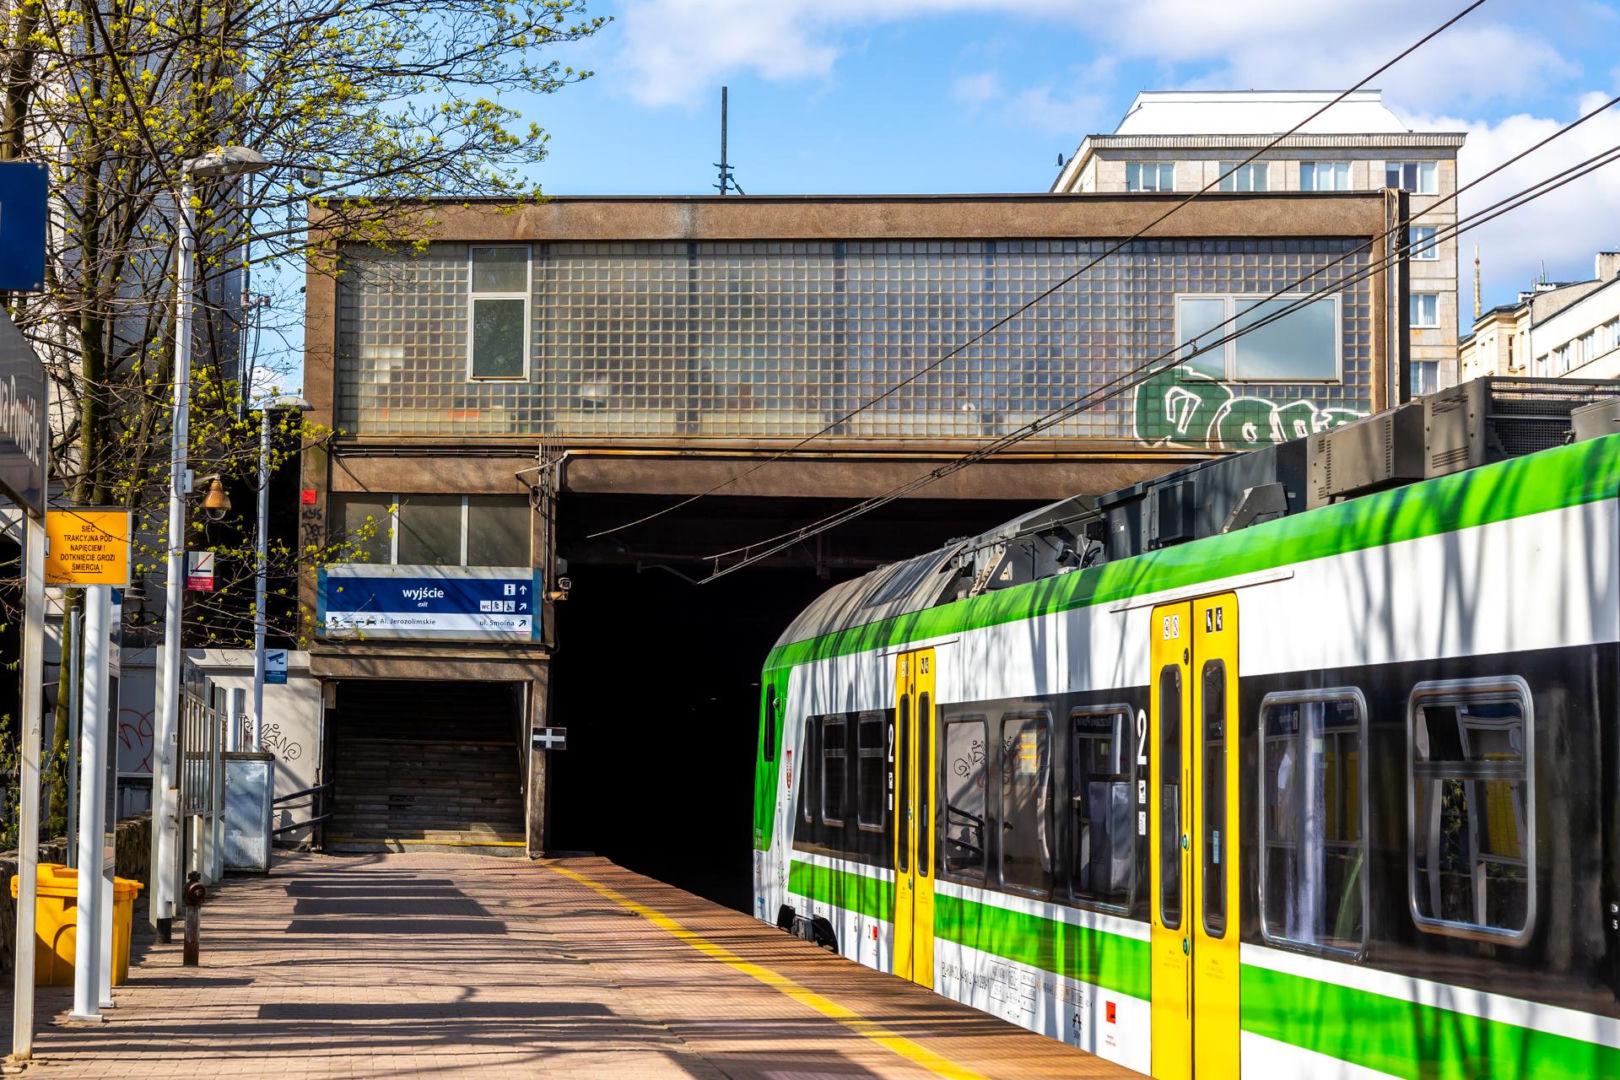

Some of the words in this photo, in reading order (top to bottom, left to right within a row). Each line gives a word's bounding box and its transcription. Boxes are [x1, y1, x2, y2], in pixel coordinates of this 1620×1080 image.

[10, 374, 40, 466] Powiśle
[60, 554, 95, 562] DOTKNIĘCIE
[402, 587, 444, 600] wyjście
[888, 723, 894, 762] 2
[1137, 709, 1147, 765] 2
